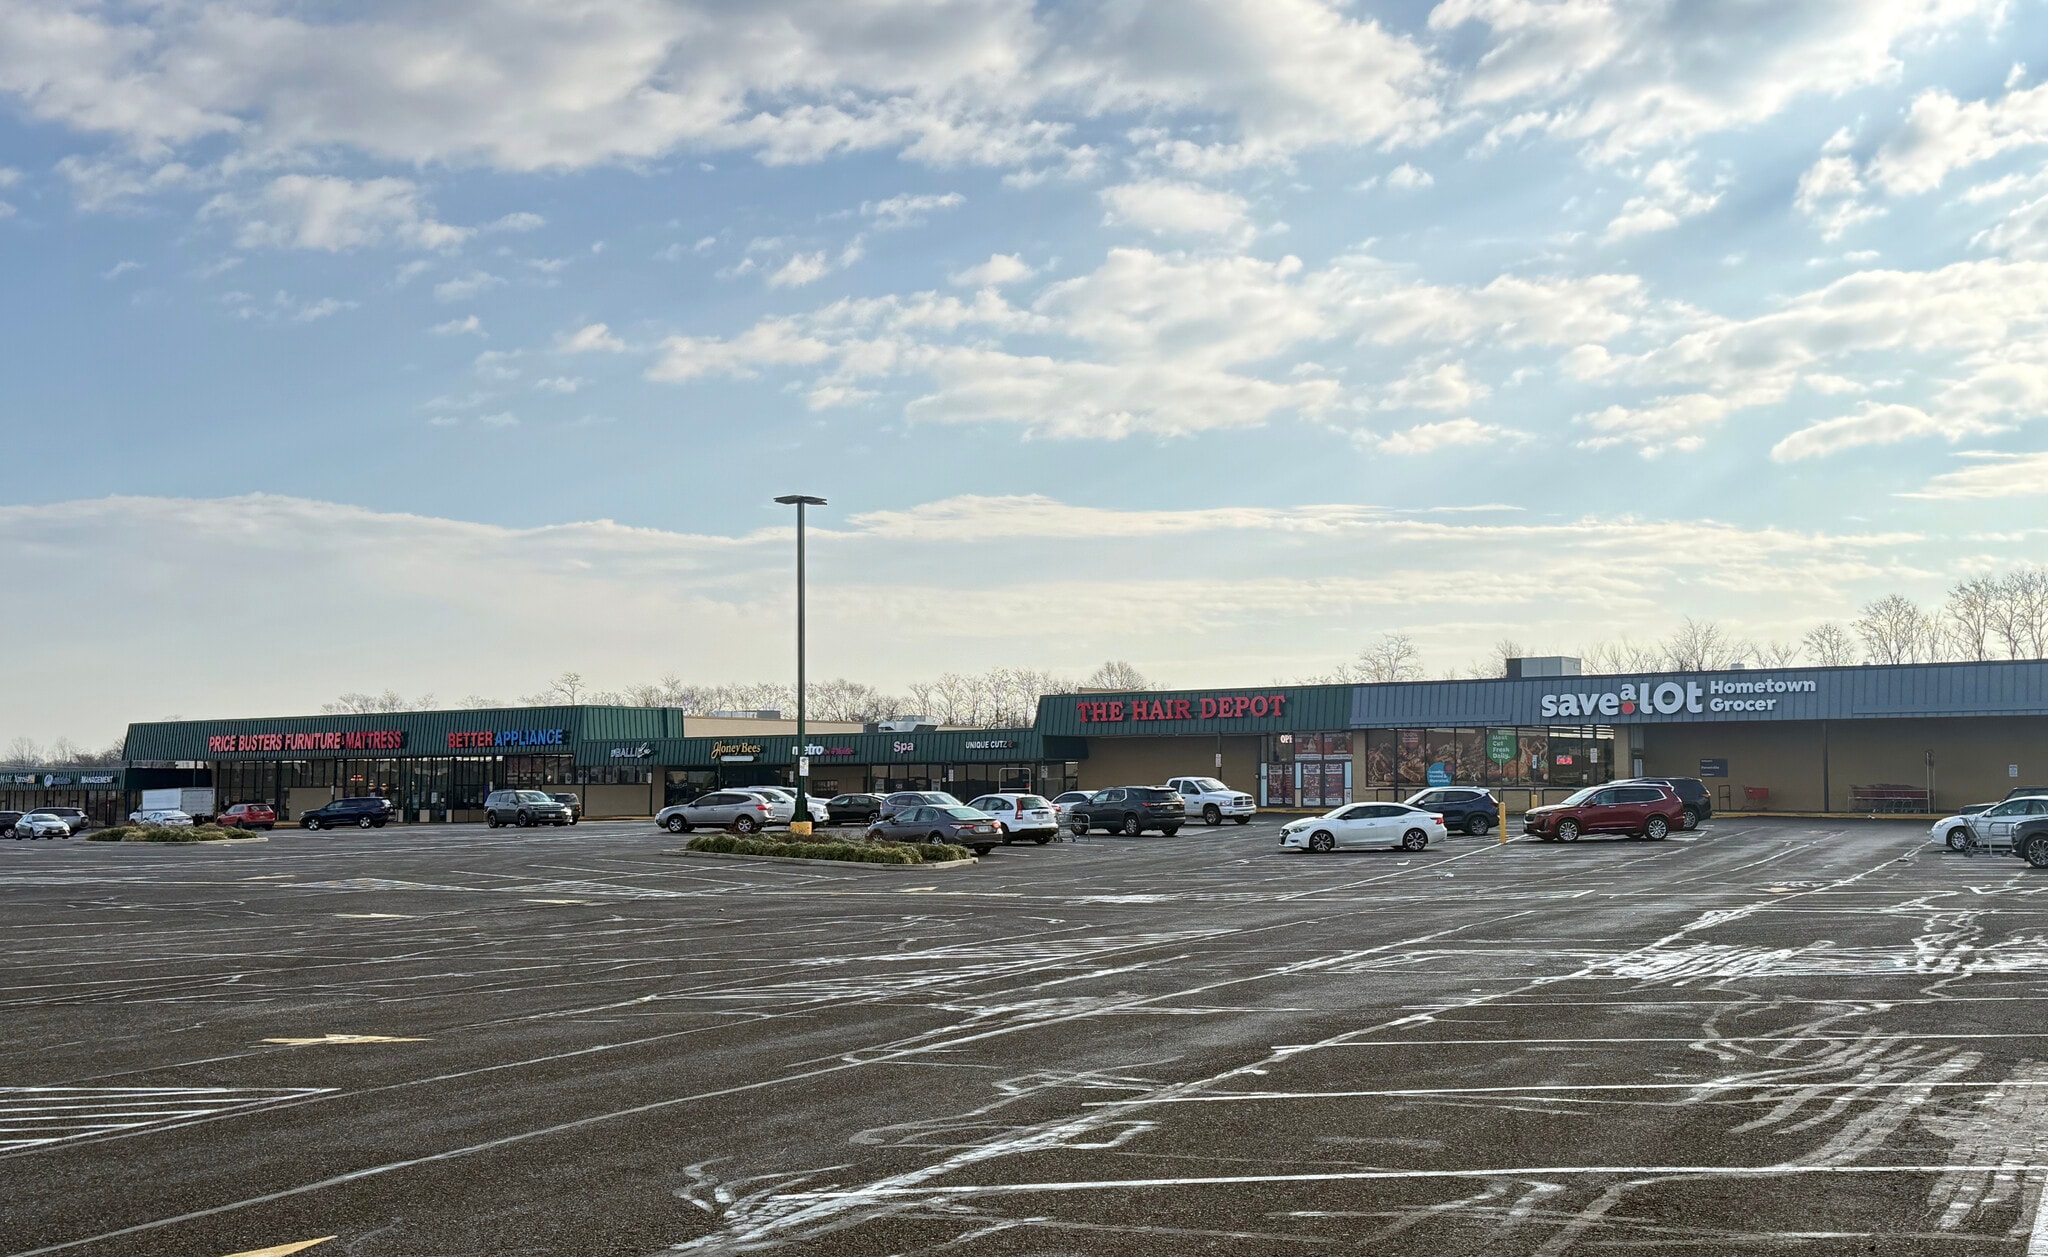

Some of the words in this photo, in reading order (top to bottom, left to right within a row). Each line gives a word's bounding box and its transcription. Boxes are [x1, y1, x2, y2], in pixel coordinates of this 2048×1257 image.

[1710, 678, 1817, 695] Hometown
[1076, 701, 1125, 723] THE
[1131, 699, 1193, 721] HAIR
[1200, 695, 1286, 719] DEPOT
[1541, 692, 1619, 717] save
[1620, 683, 1637, 700] a
[1710, 697, 1777, 712] Grocer
[208, 735, 238, 752] PRICE
[238, 733, 282, 751] BUSTERS
[285, 731, 341, 750] FURNITURE
[345, 730, 402, 749] MATTRESS
[448, 731, 493, 748] BETTER
[494, 729, 563, 746] APPLIANCE
[893, 740, 914, 754] Spa
[965, 740, 989, 749] UNIQUE
[990, 740, 1008, 749] CUTZ
[711, 740, 741, 759] Honey
[741, 742, 761, 753] Bees
[81, 775, 114, 784] MANAGEMENT
